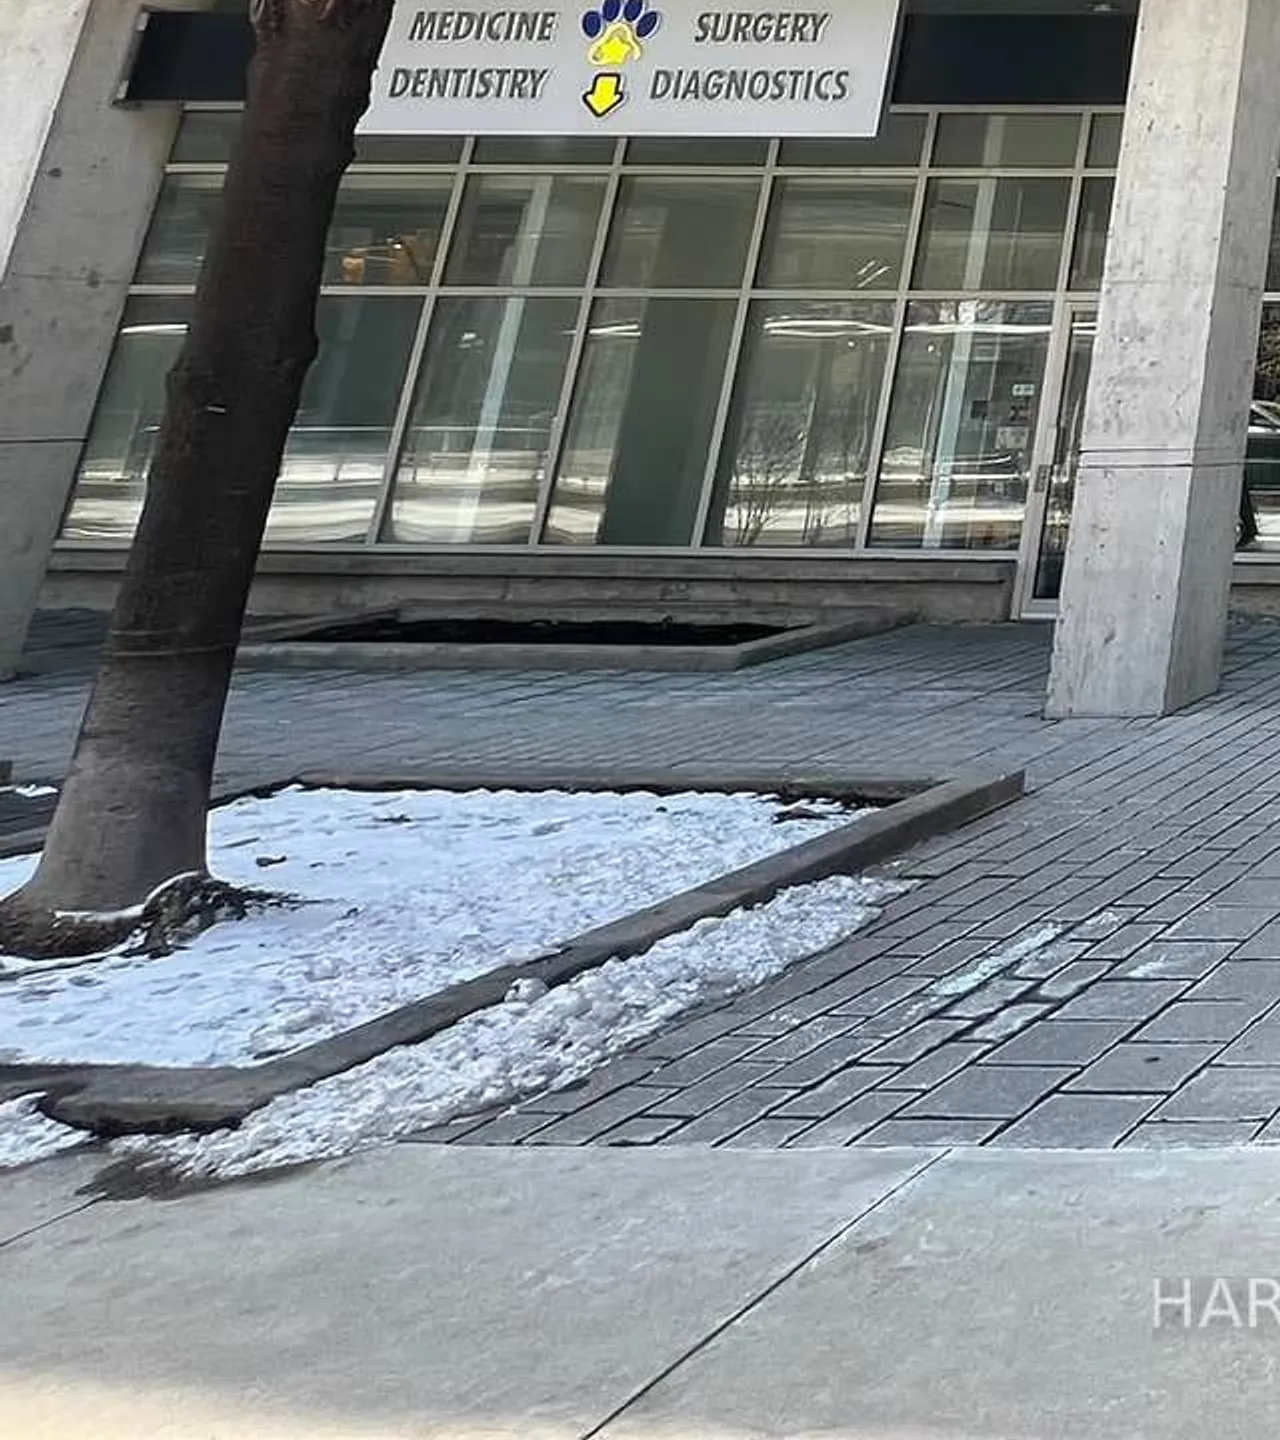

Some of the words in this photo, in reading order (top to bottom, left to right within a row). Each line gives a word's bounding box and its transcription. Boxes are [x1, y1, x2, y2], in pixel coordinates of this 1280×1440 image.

[408, 10, 558, 43] MEDICINE
[694, 12, 831, 43] SURGERY
[389, 67, 549, 100] DENTISTRY
[650, 69, 851, 102] DIAGNOSTICS
